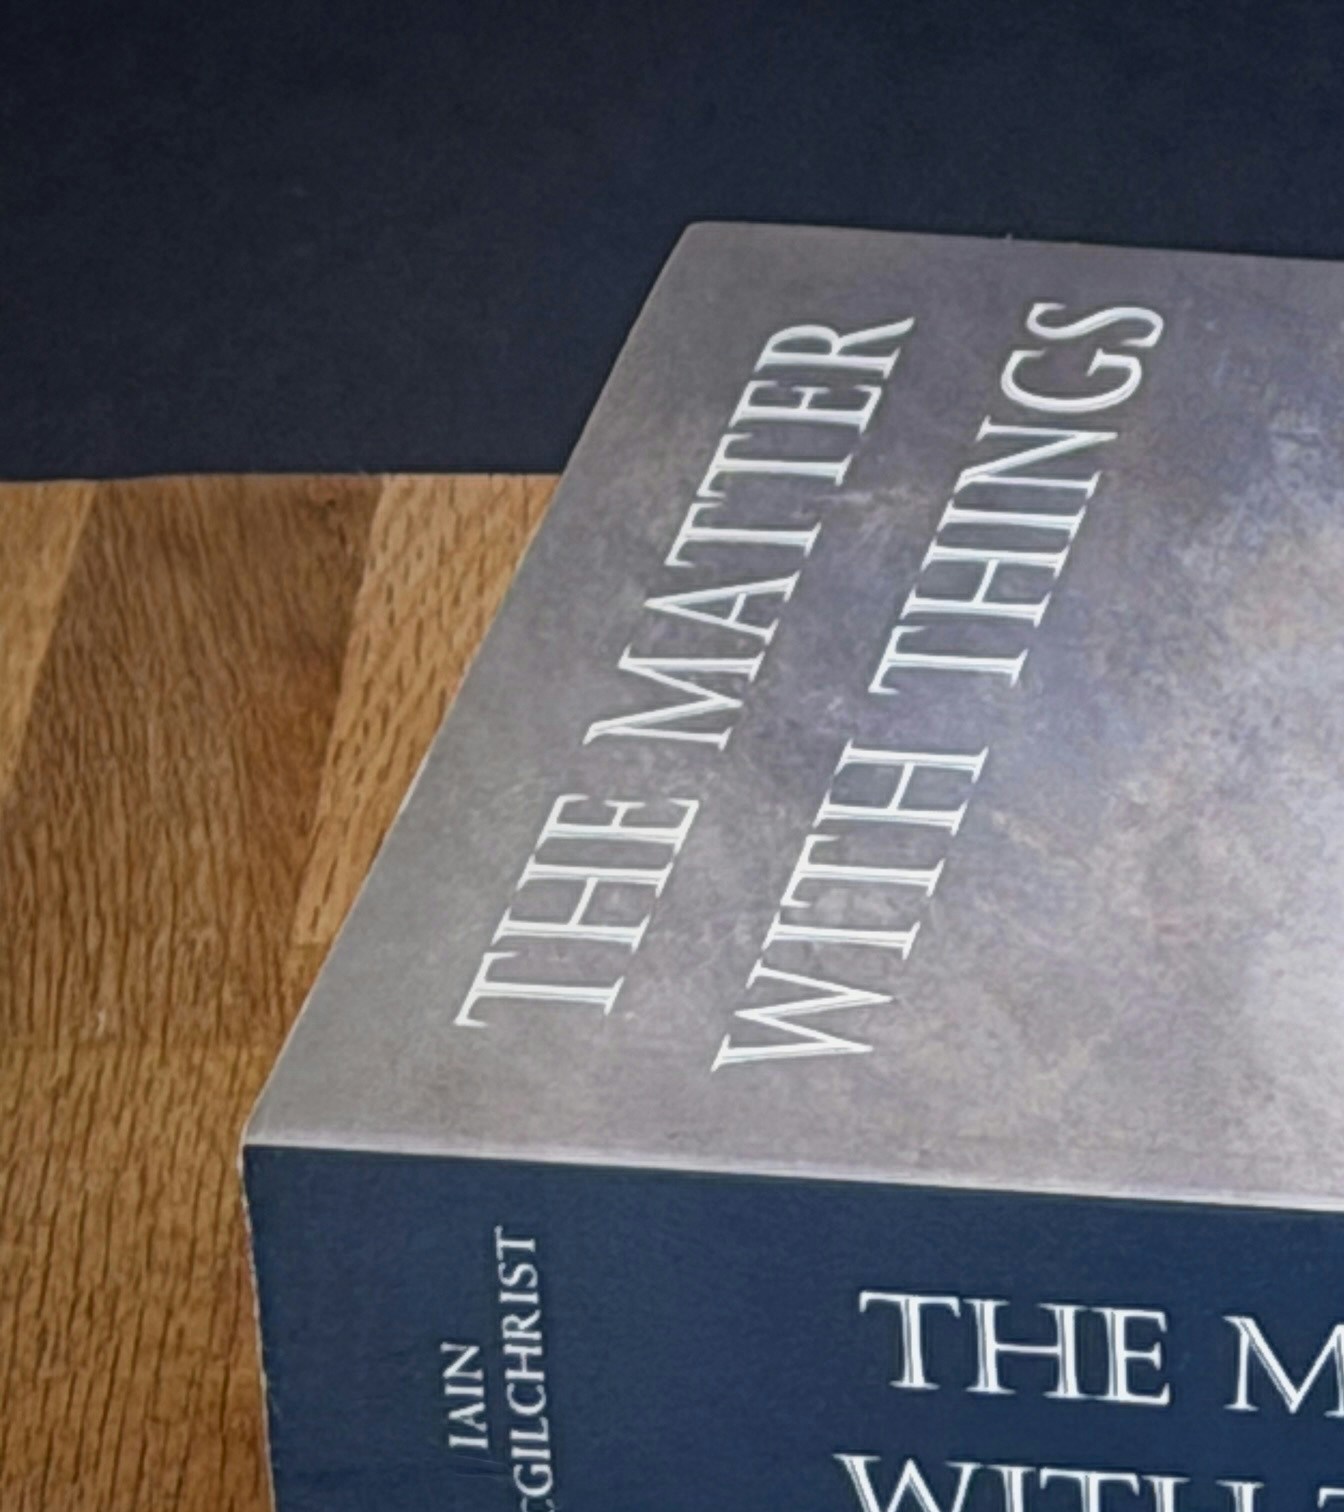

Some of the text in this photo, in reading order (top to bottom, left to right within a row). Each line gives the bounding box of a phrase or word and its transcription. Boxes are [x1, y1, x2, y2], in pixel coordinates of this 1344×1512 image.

[453, 318, 914, 1028] THE MATTER
[710, 303, 1164, 1073] WITH THINGS
[440, 1343, 489, 1449] IAIN
[859, 1291, 1170, 1406] THE
